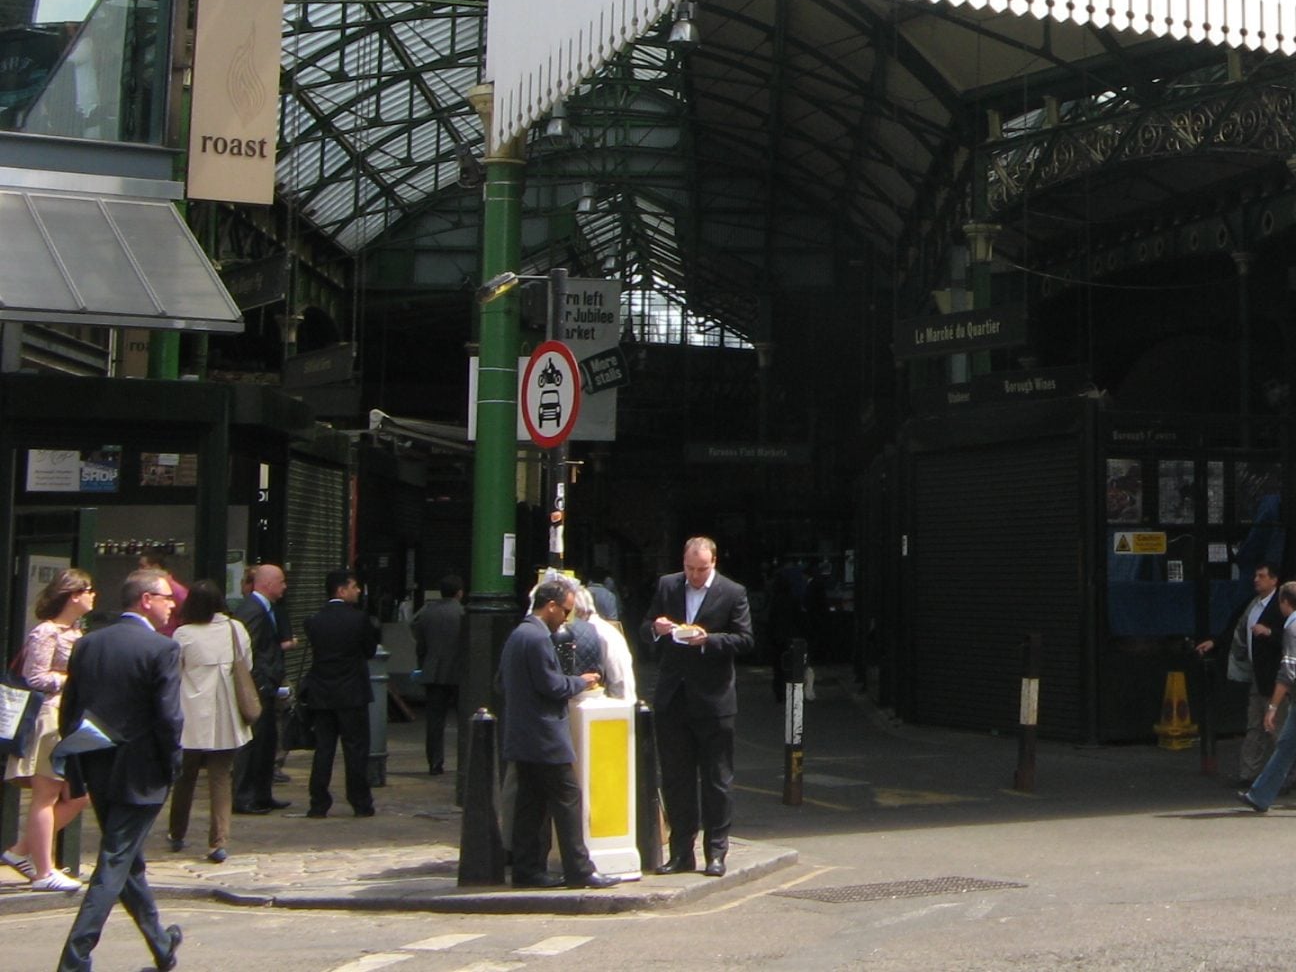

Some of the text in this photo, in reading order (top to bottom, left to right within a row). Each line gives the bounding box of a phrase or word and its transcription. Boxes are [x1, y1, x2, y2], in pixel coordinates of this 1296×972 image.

[201, 135, 268, 158] roast
[583, 290, 604, 306] left
[574, 308, 614, 324] Jubilee
[565, 327, 596, 340] arket
[915, 318, 1000, 344] Le Marché du Quartier
[590, 356, 618, 373] More
[594, 368, 621, 386] stalls
